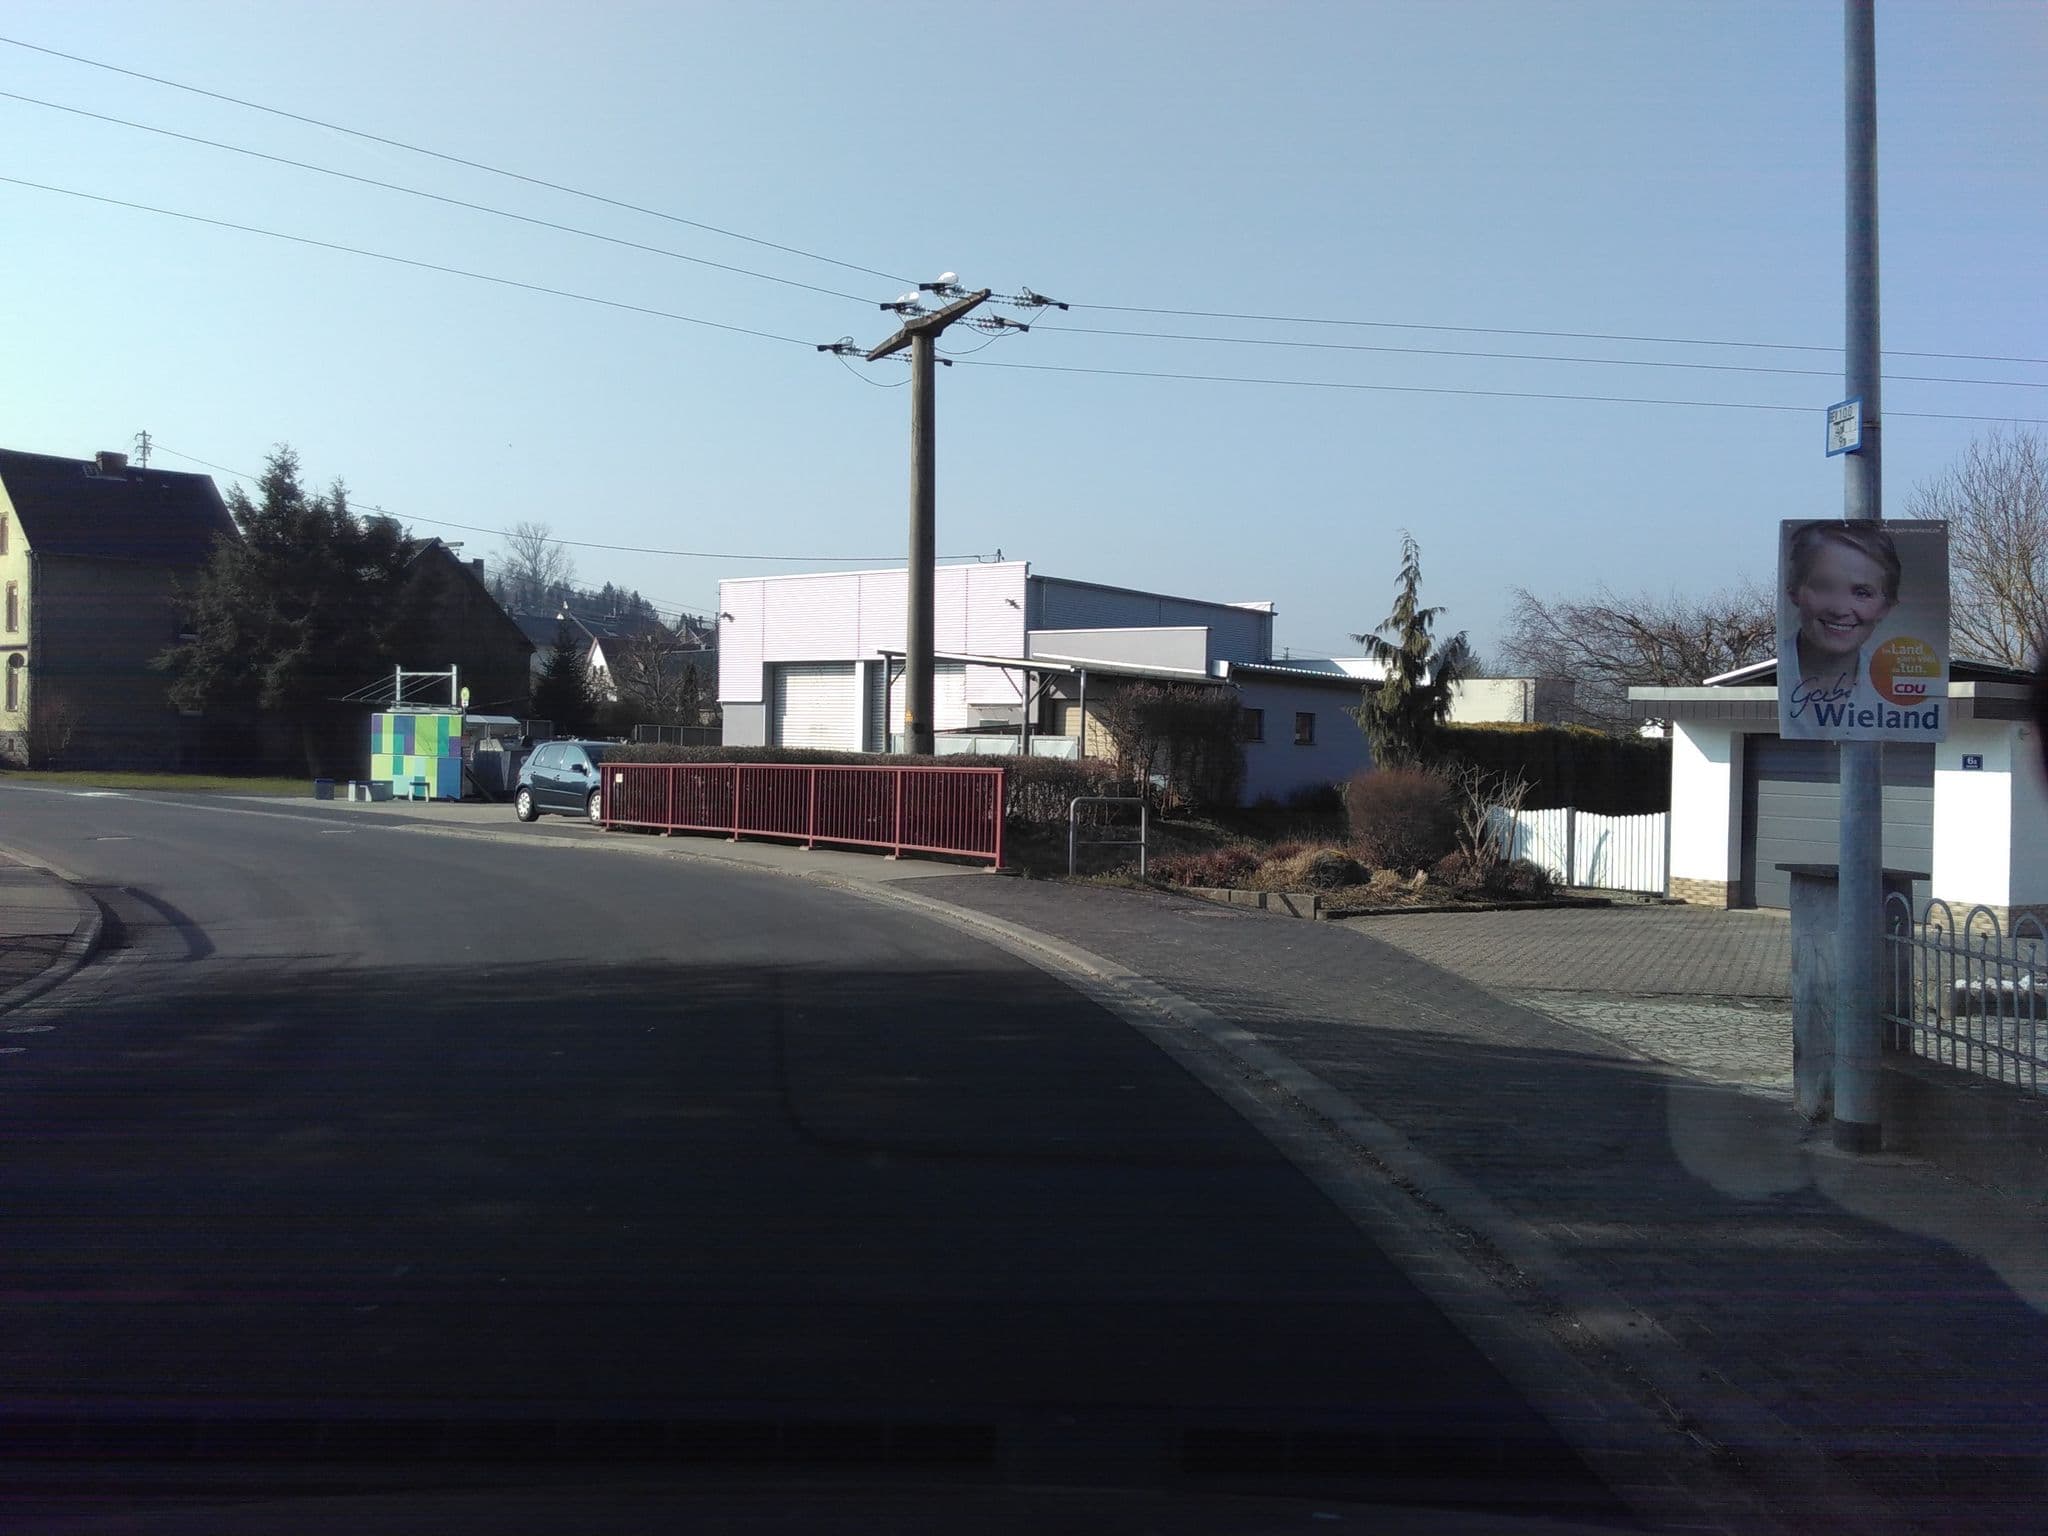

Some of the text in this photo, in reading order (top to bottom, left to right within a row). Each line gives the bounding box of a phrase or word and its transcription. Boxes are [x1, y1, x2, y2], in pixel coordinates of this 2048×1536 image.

[1892, 642, 1924, 655] Land
[1790, 672, 1858, 718] Gabi
[1894, 683, 1927, 694] CDU
[1814, 702, 1940, 730] Wieland
